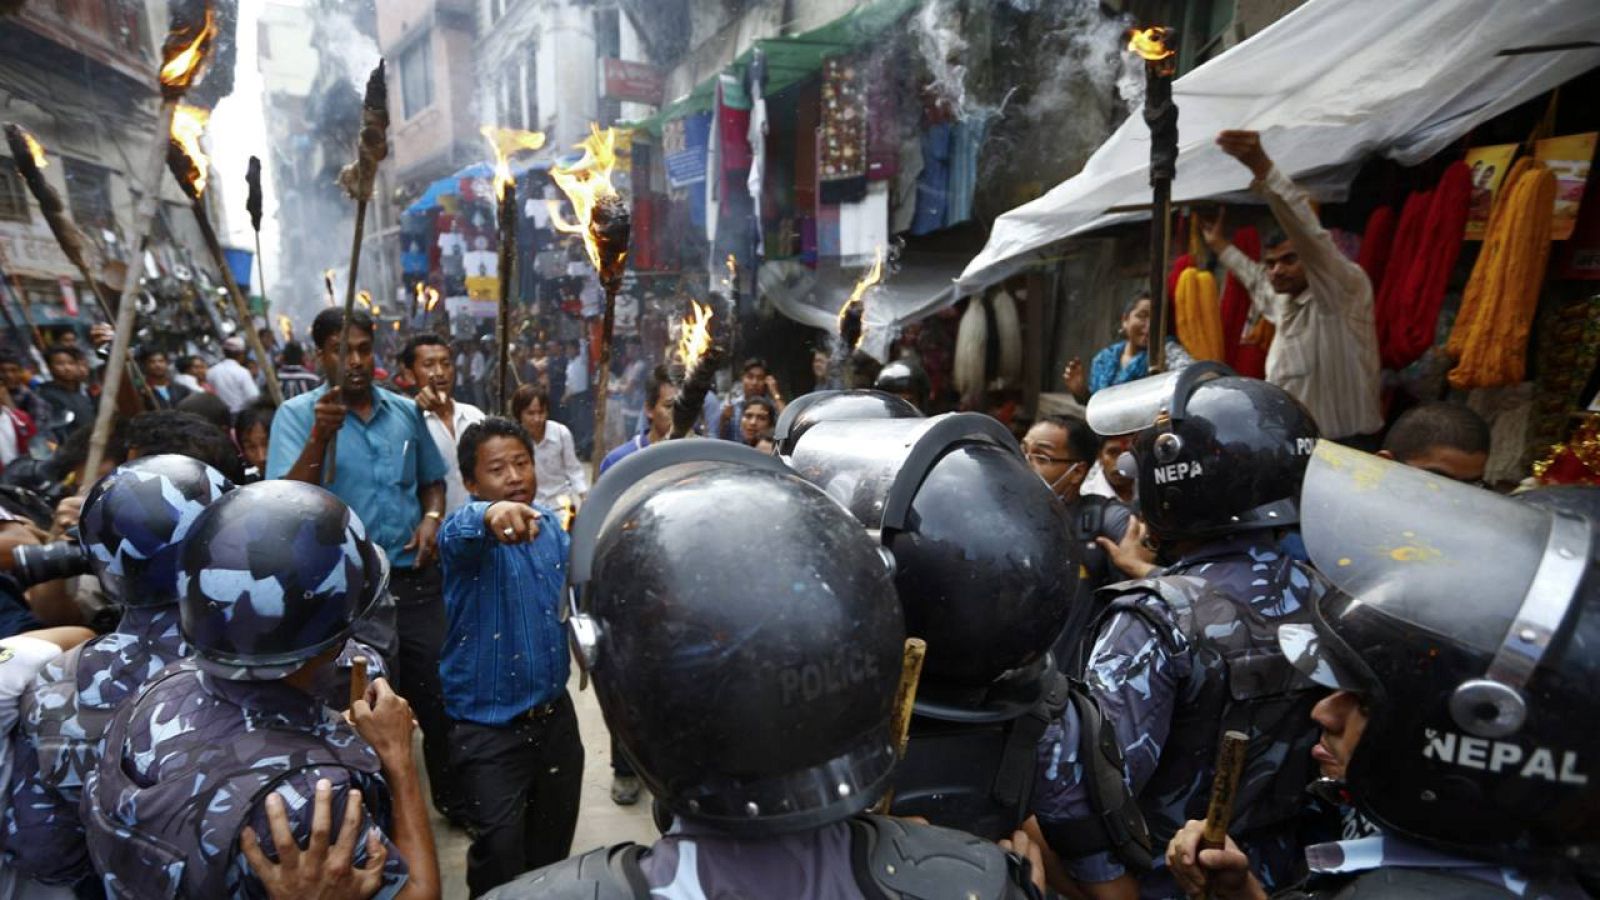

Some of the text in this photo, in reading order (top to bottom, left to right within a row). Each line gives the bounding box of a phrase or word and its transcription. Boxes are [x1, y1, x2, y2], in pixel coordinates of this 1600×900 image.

[1154, 461, 1202, 484] NEPA
[780, 651, 880, 706] POLICE
[1422, 728, 1588, 784] NEPAL
